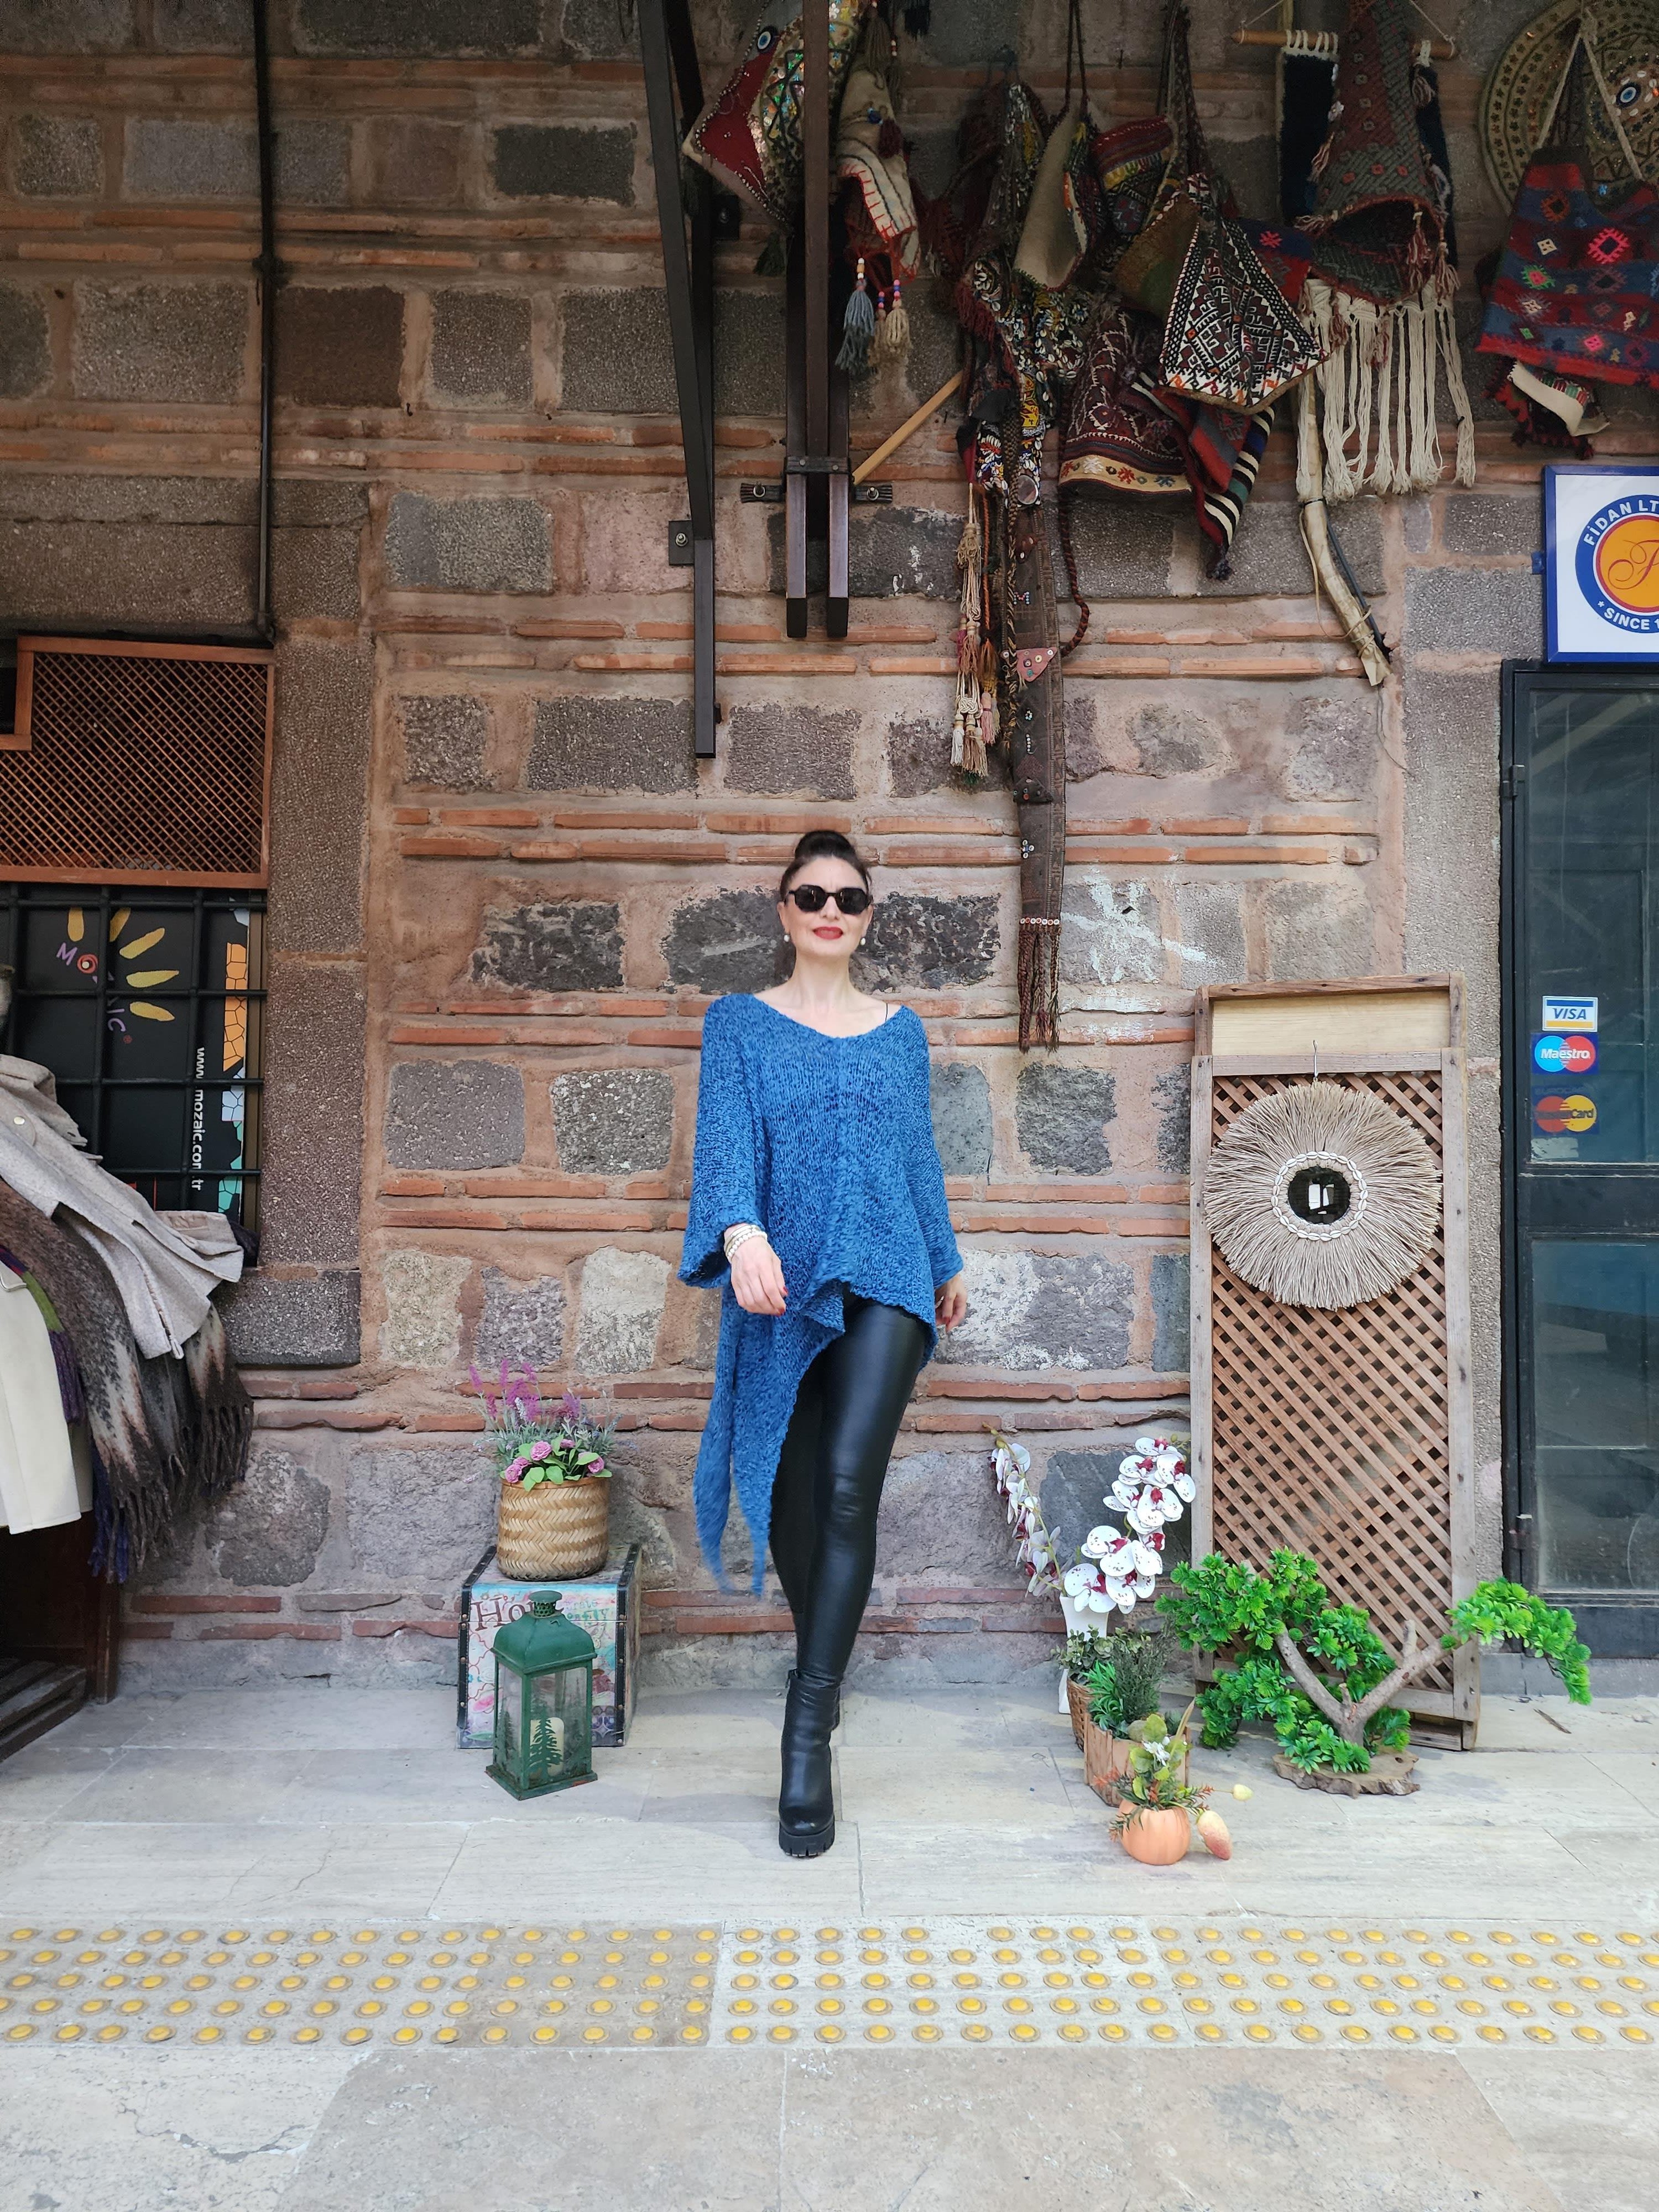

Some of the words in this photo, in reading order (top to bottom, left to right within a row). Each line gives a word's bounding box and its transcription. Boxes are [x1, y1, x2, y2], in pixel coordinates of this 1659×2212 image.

[1583, 502, 1632, 546] FİDAN
[1604, 607, 1650, 630] SINCE
[1552, 1008, 1587, 1020] VISA
[1540, 1048, 1590, 1060] Maestro
